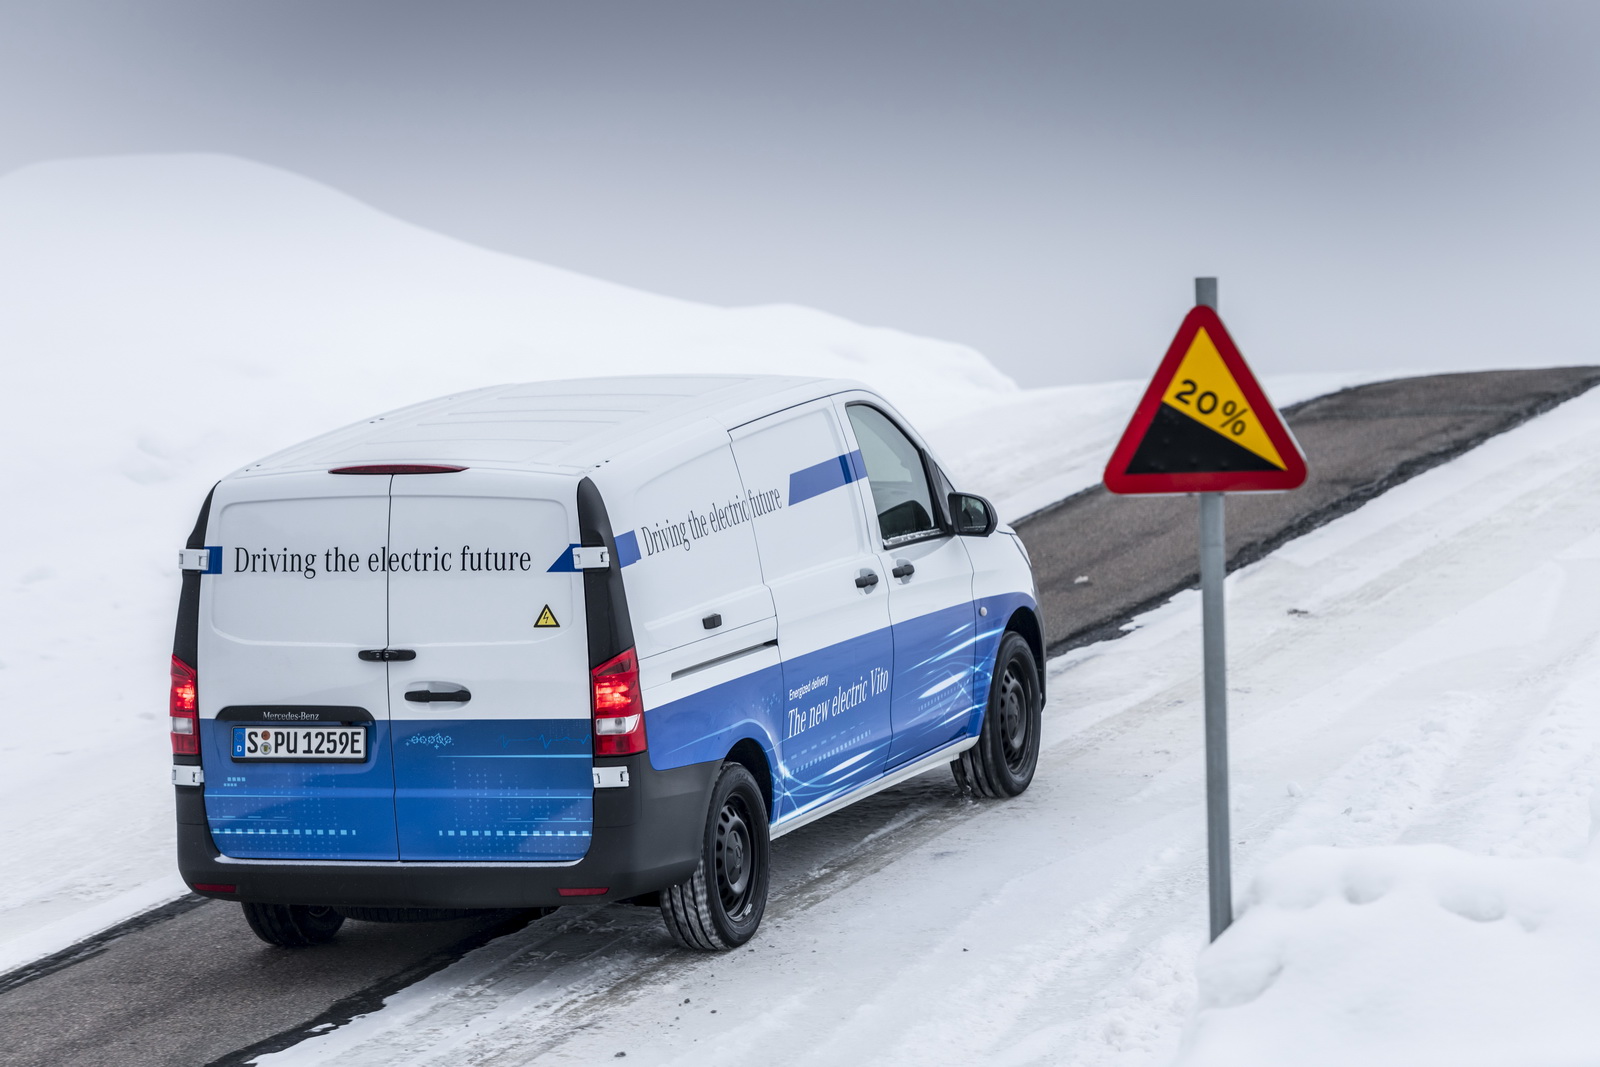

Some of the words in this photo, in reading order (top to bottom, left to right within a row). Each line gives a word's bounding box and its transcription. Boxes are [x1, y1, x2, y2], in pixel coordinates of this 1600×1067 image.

[1174, 379, 1248, 436] 20%
[641, 519, 691, 556] Driving
[688, 510, 709, 540] the
[709, 494, 750, 533] electric
[747, 488, 783, 519] future
[234, 547, 316, 579] Driving
[325, 546, 360, 573] the
[368, 546, 452, 573] electric
[460, 545, 532, 573] future
[787, 707, 807, 739] The
[808, 699, 831, 730] new
[831, 676, 868, 717] electric
[870, 666, 889, 698] Vito
[788, 680, 811, 701] Energized
[811, 674, 829, 691] delivery
[262, 711, 320, 721] Mercedes-Benz
[302, 731, 362, 754] 1259E
